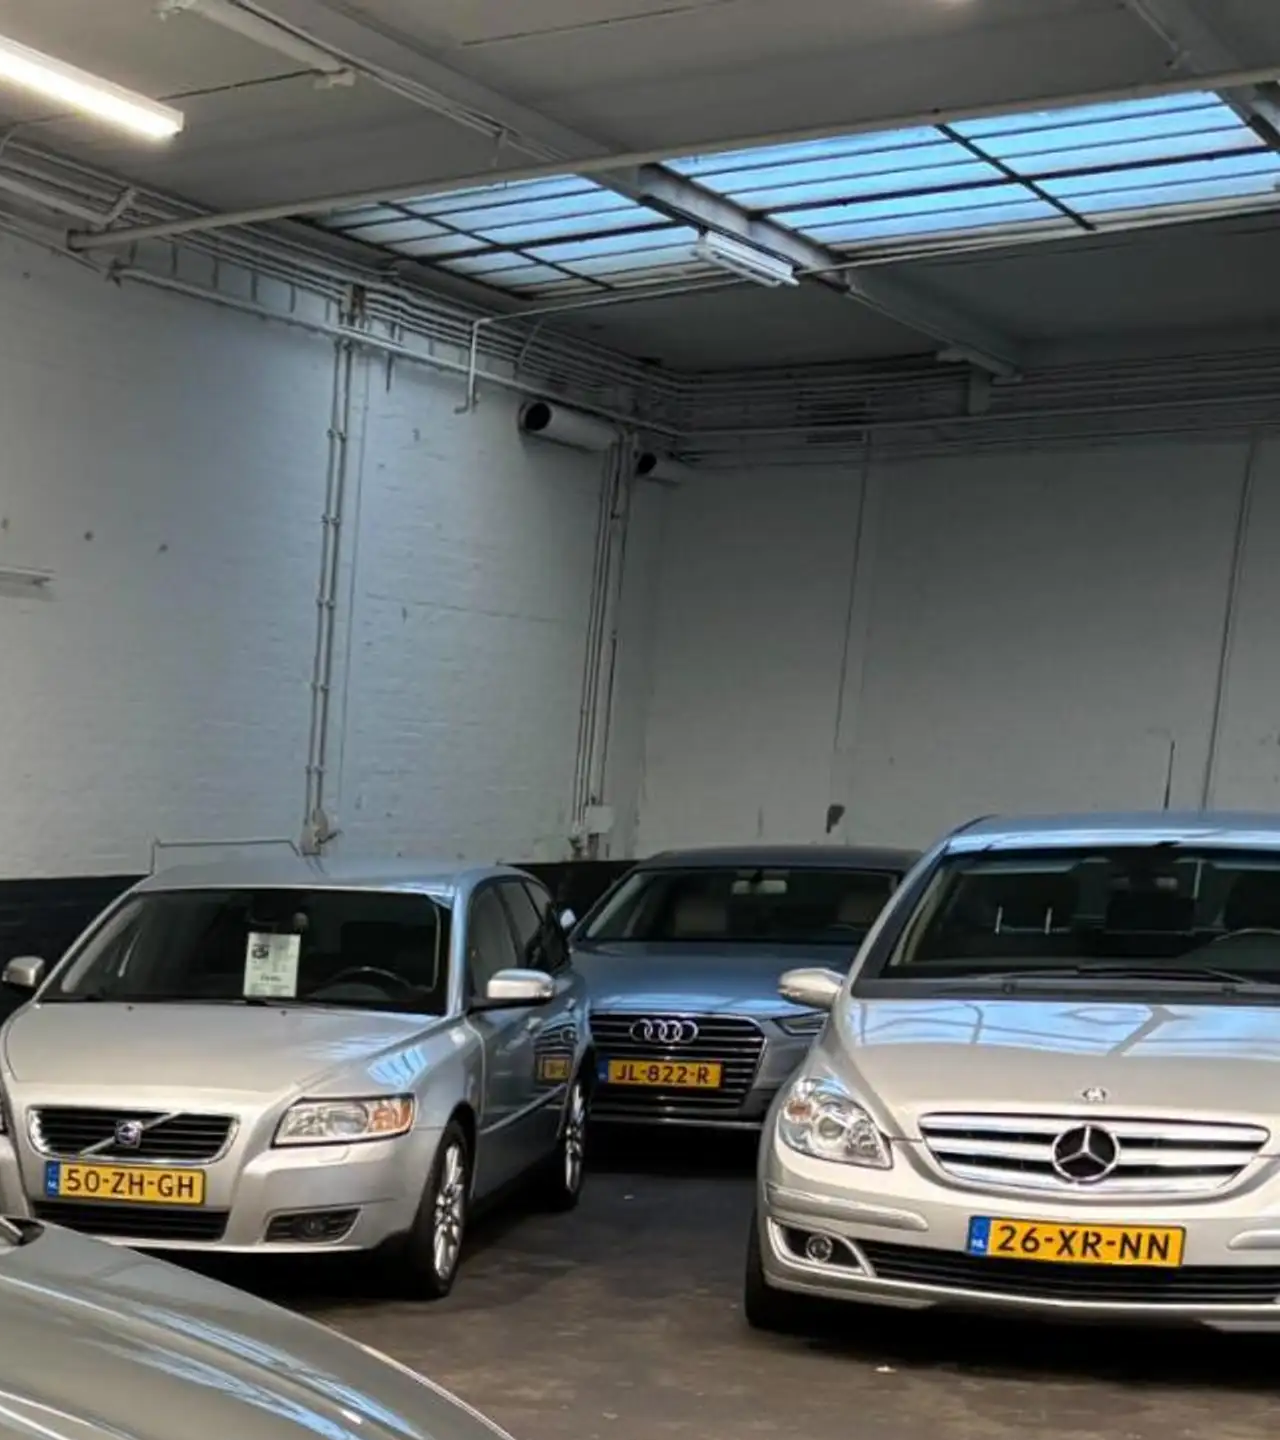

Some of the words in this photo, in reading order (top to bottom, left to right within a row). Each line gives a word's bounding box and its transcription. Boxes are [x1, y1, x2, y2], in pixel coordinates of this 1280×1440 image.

[615, 1063, 710, 1085] JL-822-R
[65, 1168, 194, 1198] 50-ZH-GH
[997, 1225, 1170, 1261] 26-XR-NN
